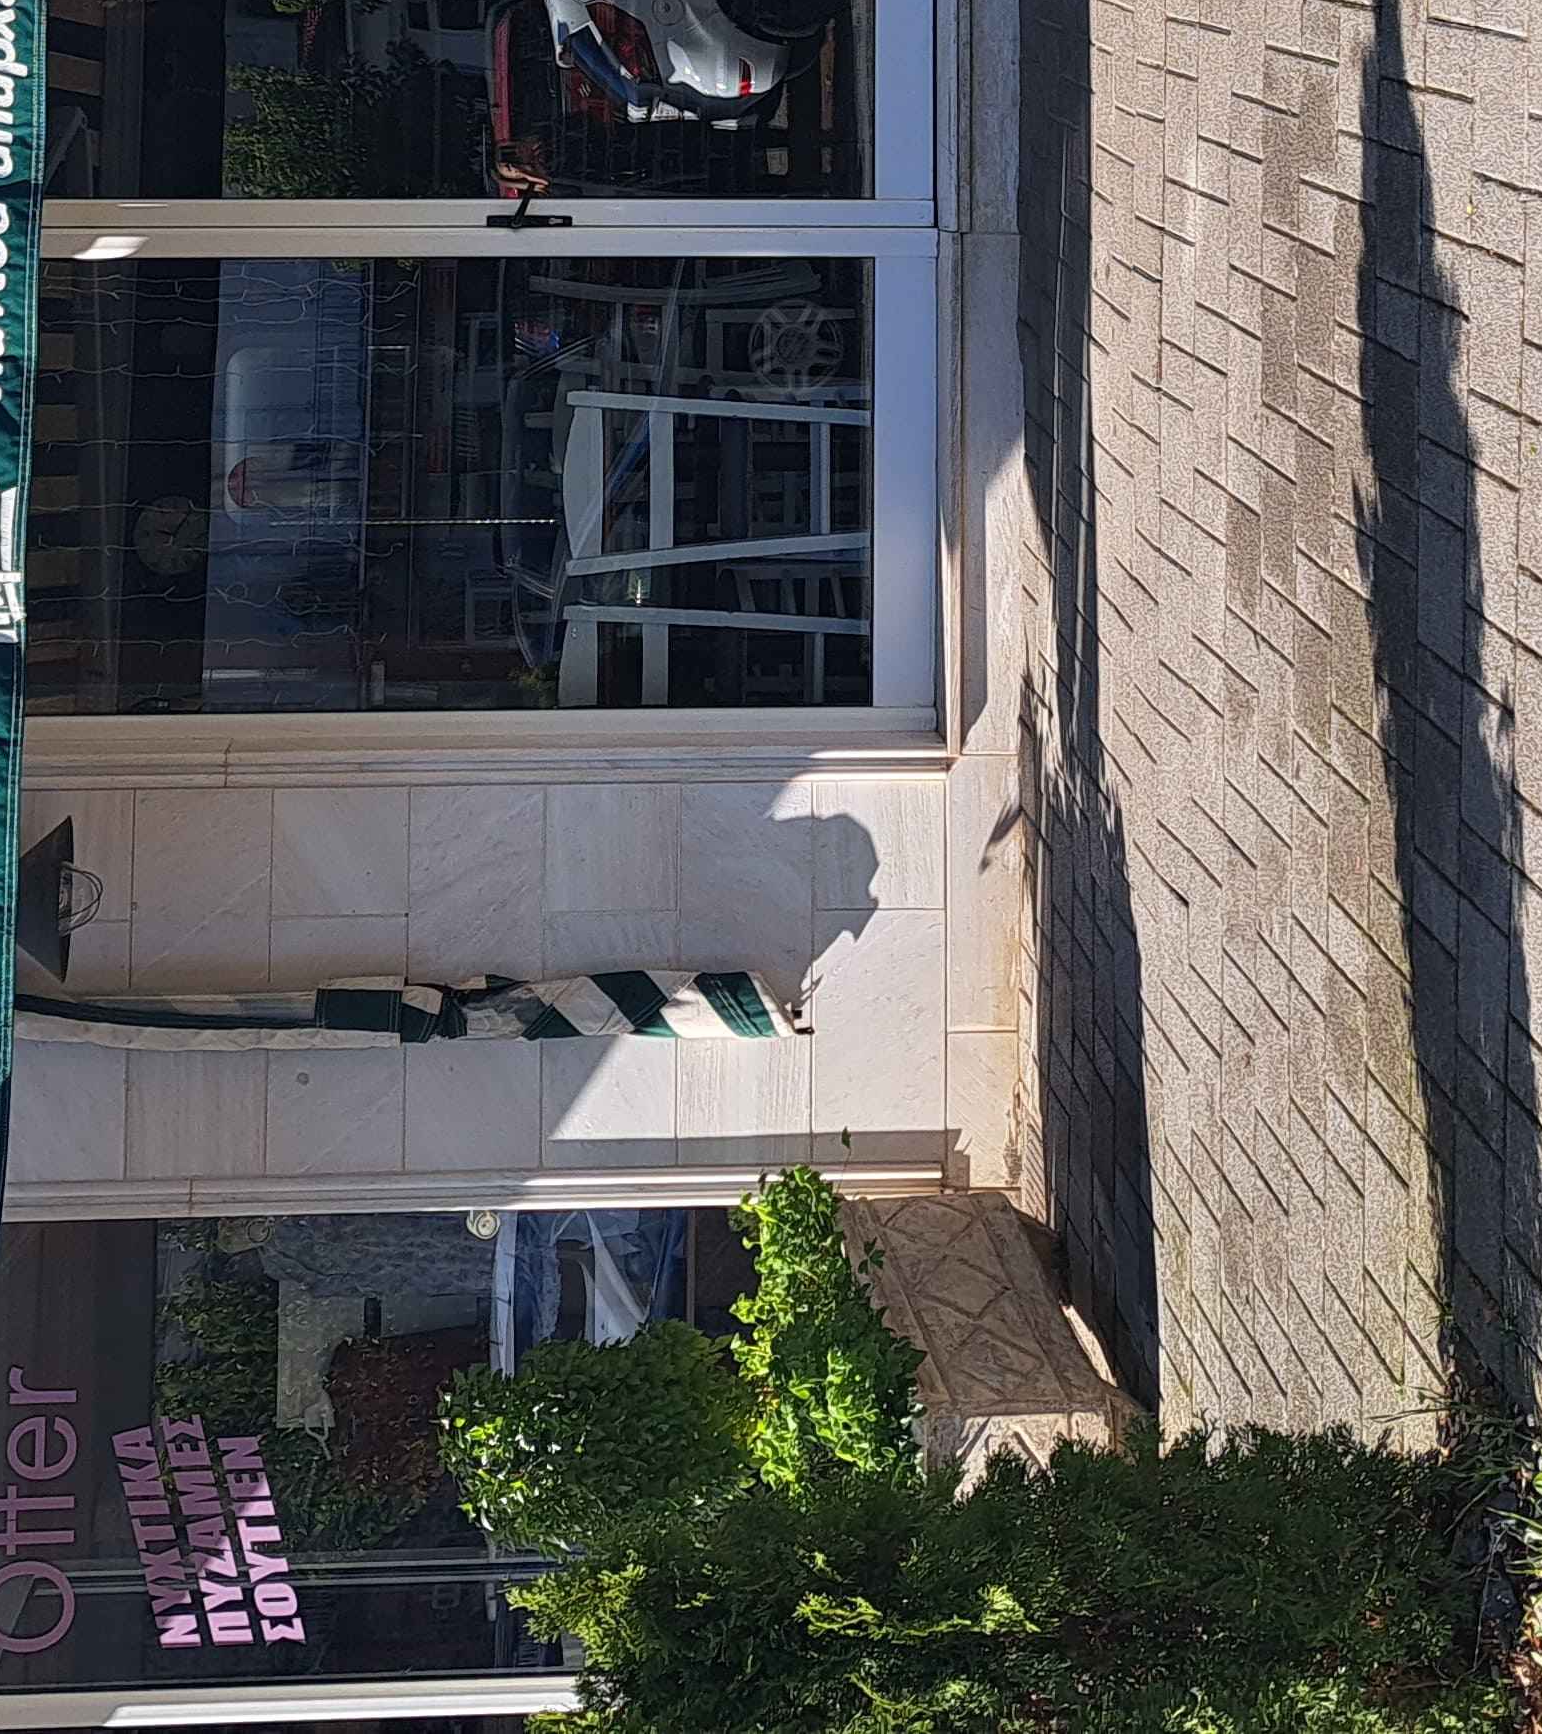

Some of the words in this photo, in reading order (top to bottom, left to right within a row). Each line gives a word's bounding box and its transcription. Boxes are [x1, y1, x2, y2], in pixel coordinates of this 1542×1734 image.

[111, 1426, 201, 1648] ΝΥΧΤΙΚΑ
[161, 1414, 254, 1646] ΠΥΖΑΜΕΣ
[216, 1435, 306, 1644] ΣΟΥΤΙΕΝ
